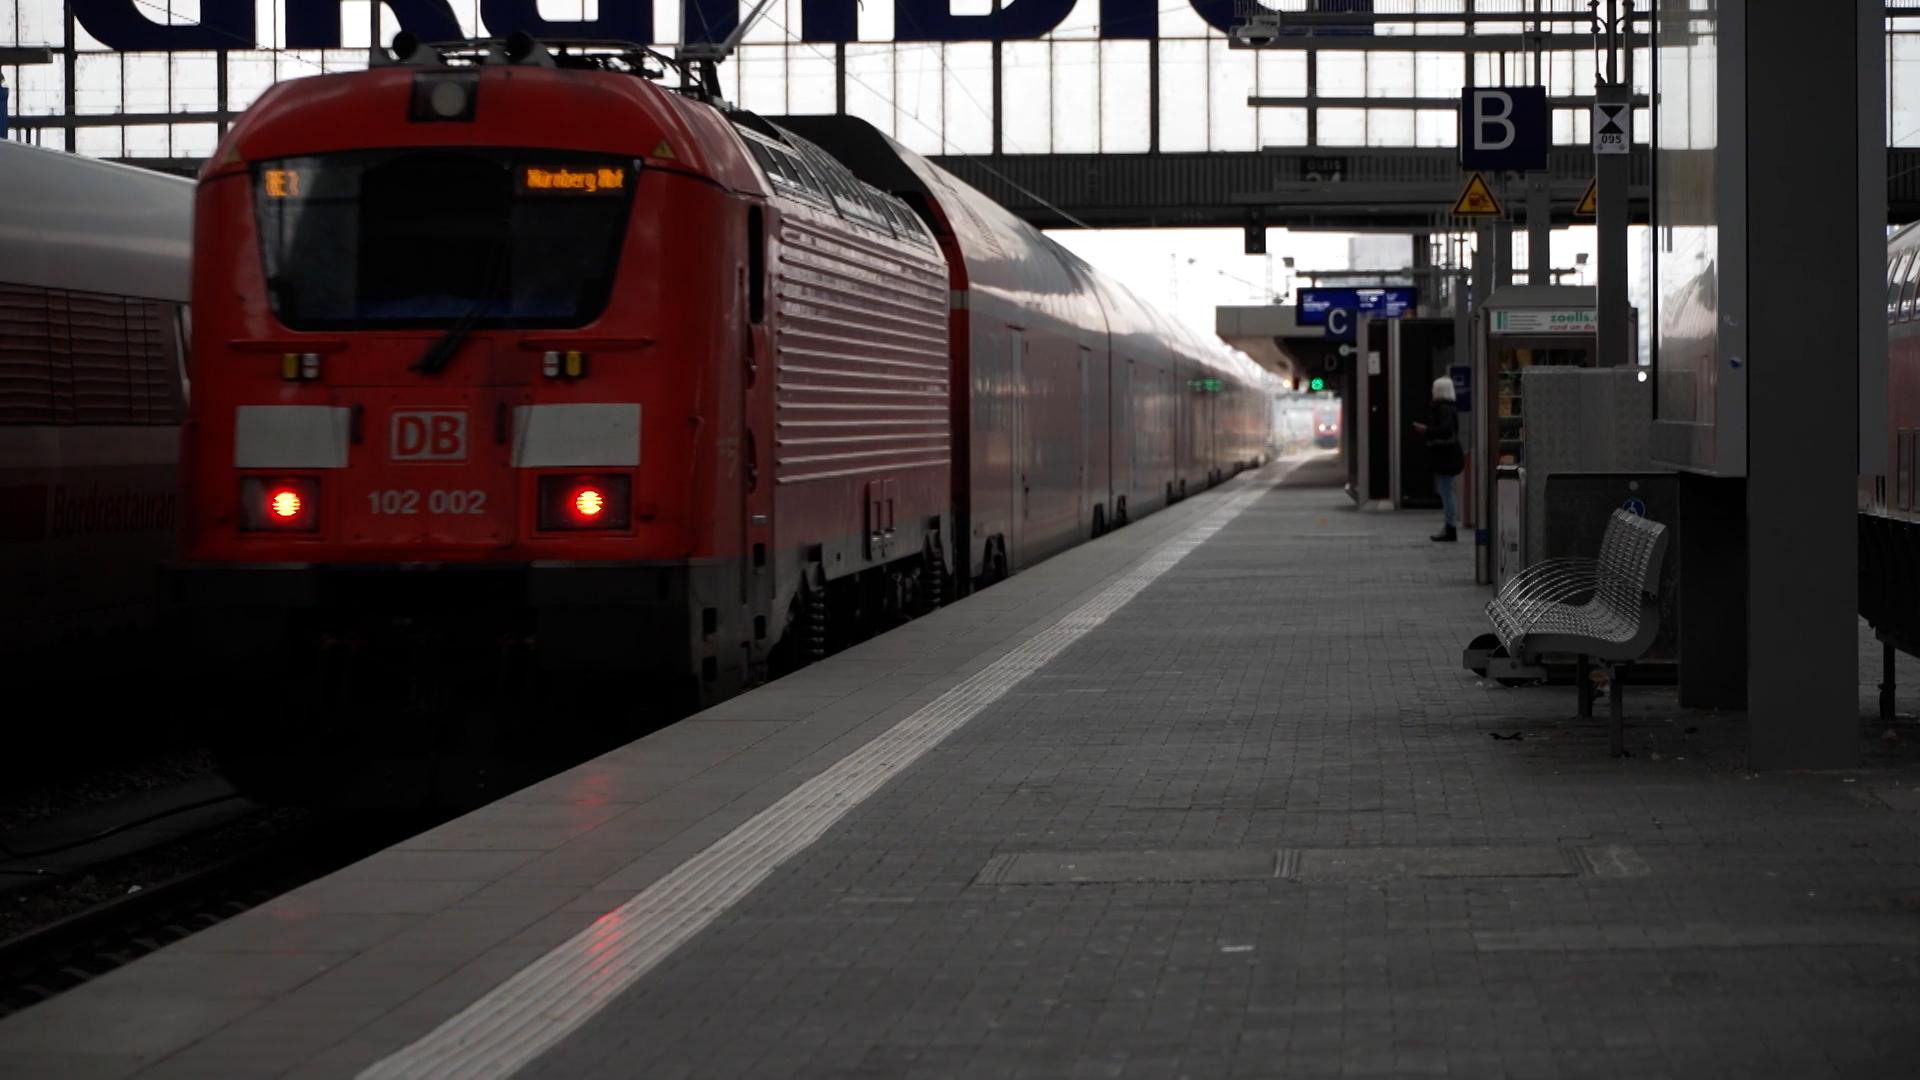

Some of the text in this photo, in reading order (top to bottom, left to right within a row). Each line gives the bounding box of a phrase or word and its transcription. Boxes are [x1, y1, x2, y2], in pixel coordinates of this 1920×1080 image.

[1474, 90, 1516, 150] B
[1601, 135, 1622, 144] 095
[527, 168, 597, 192] Nürnberg
[1328, 307, 1348, 335] C
[1550, 312, 1597, 322] zoells.
[1323, 353, 1338, 371] D
[397, 415, 460, 457] DB
[52, 483, 177, 536] Bordrestauran
[368, 489, 487, 514] 102 002
